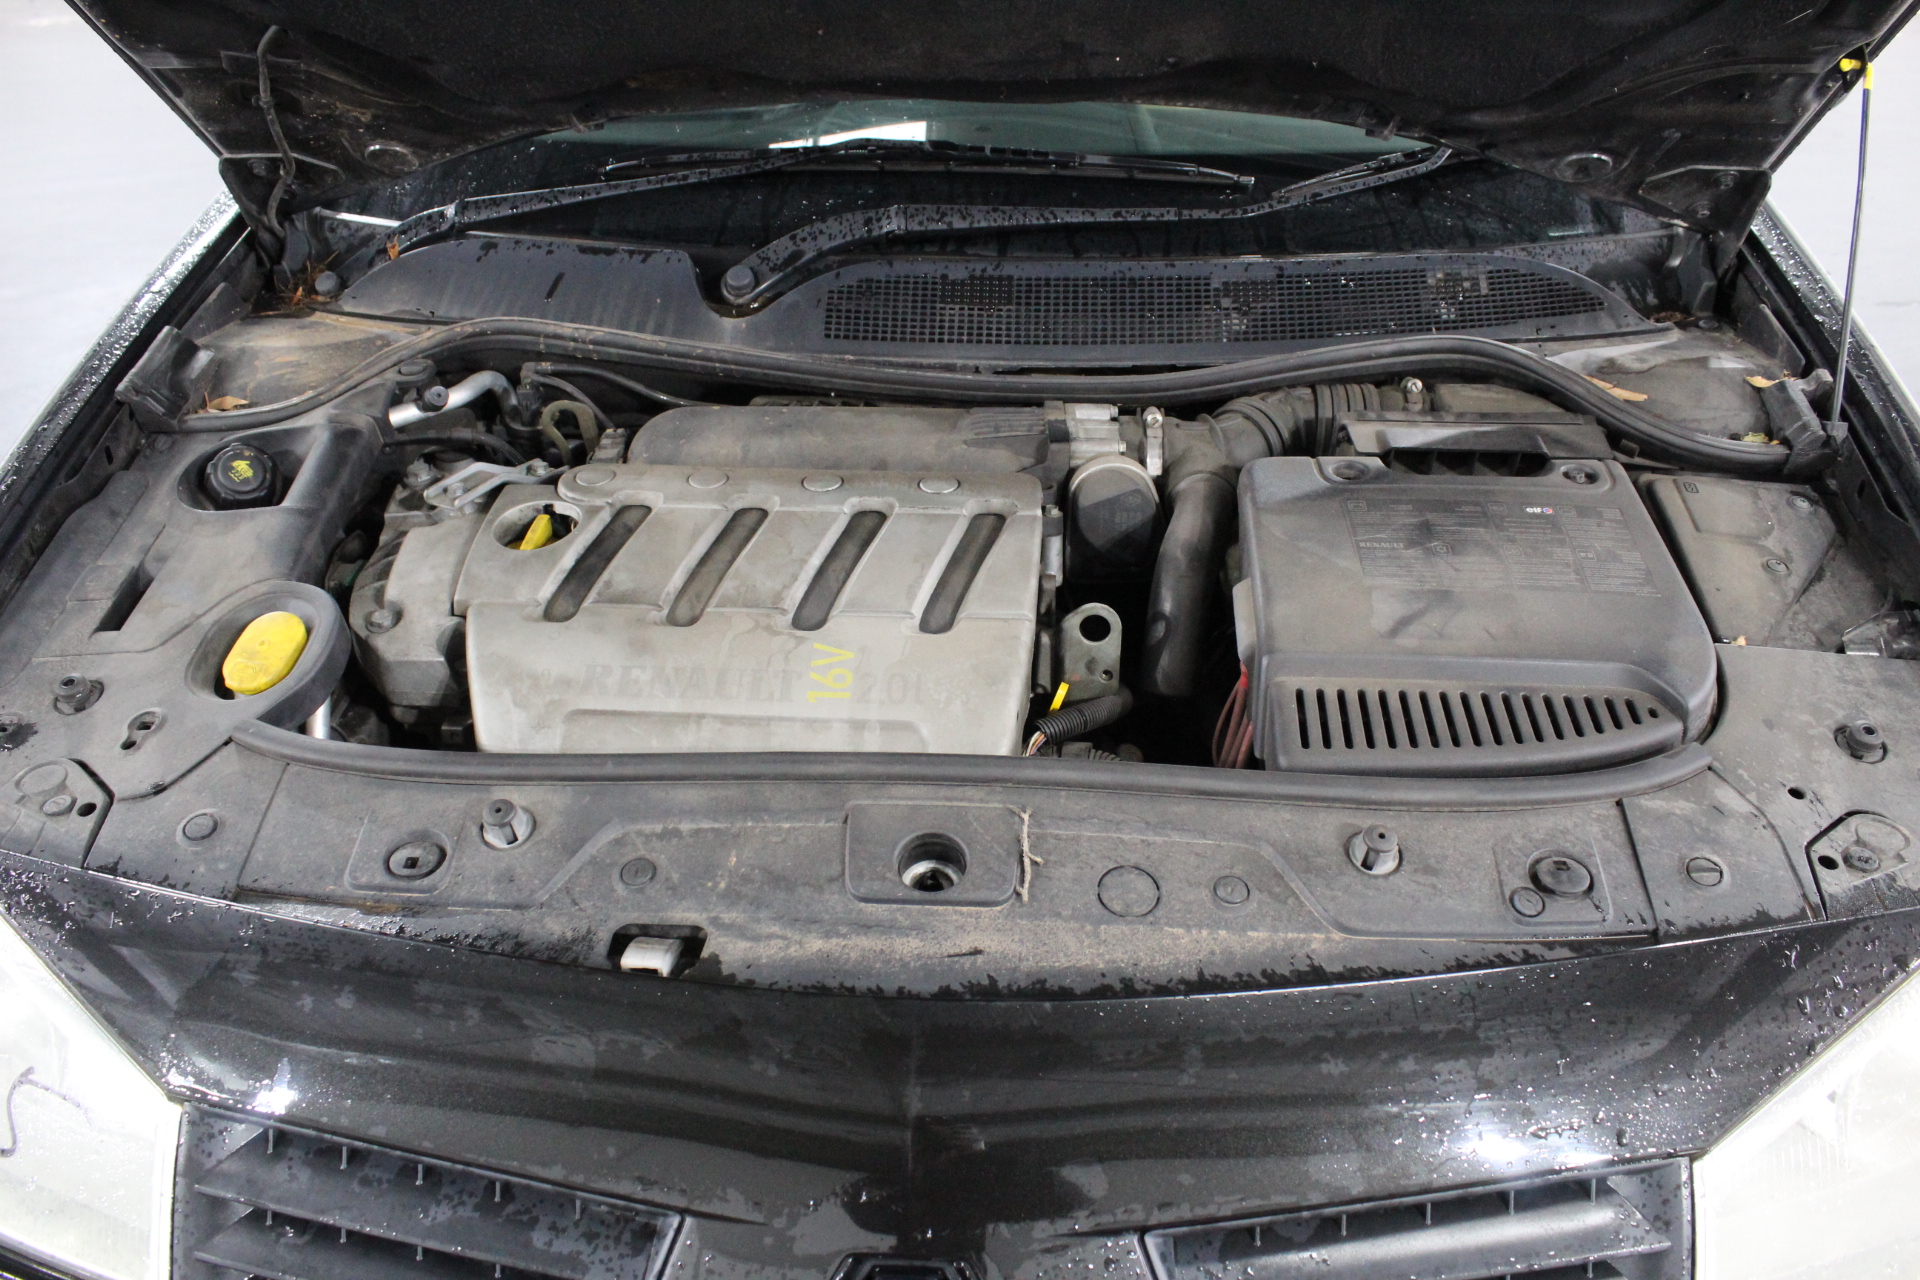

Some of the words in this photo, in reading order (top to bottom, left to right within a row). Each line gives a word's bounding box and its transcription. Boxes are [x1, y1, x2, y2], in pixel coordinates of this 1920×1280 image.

[1359, 541, 1405, 549] RENAULT
[580, 663, 803, 703] RENAULT
[807, 643, 855, 703] 16V
